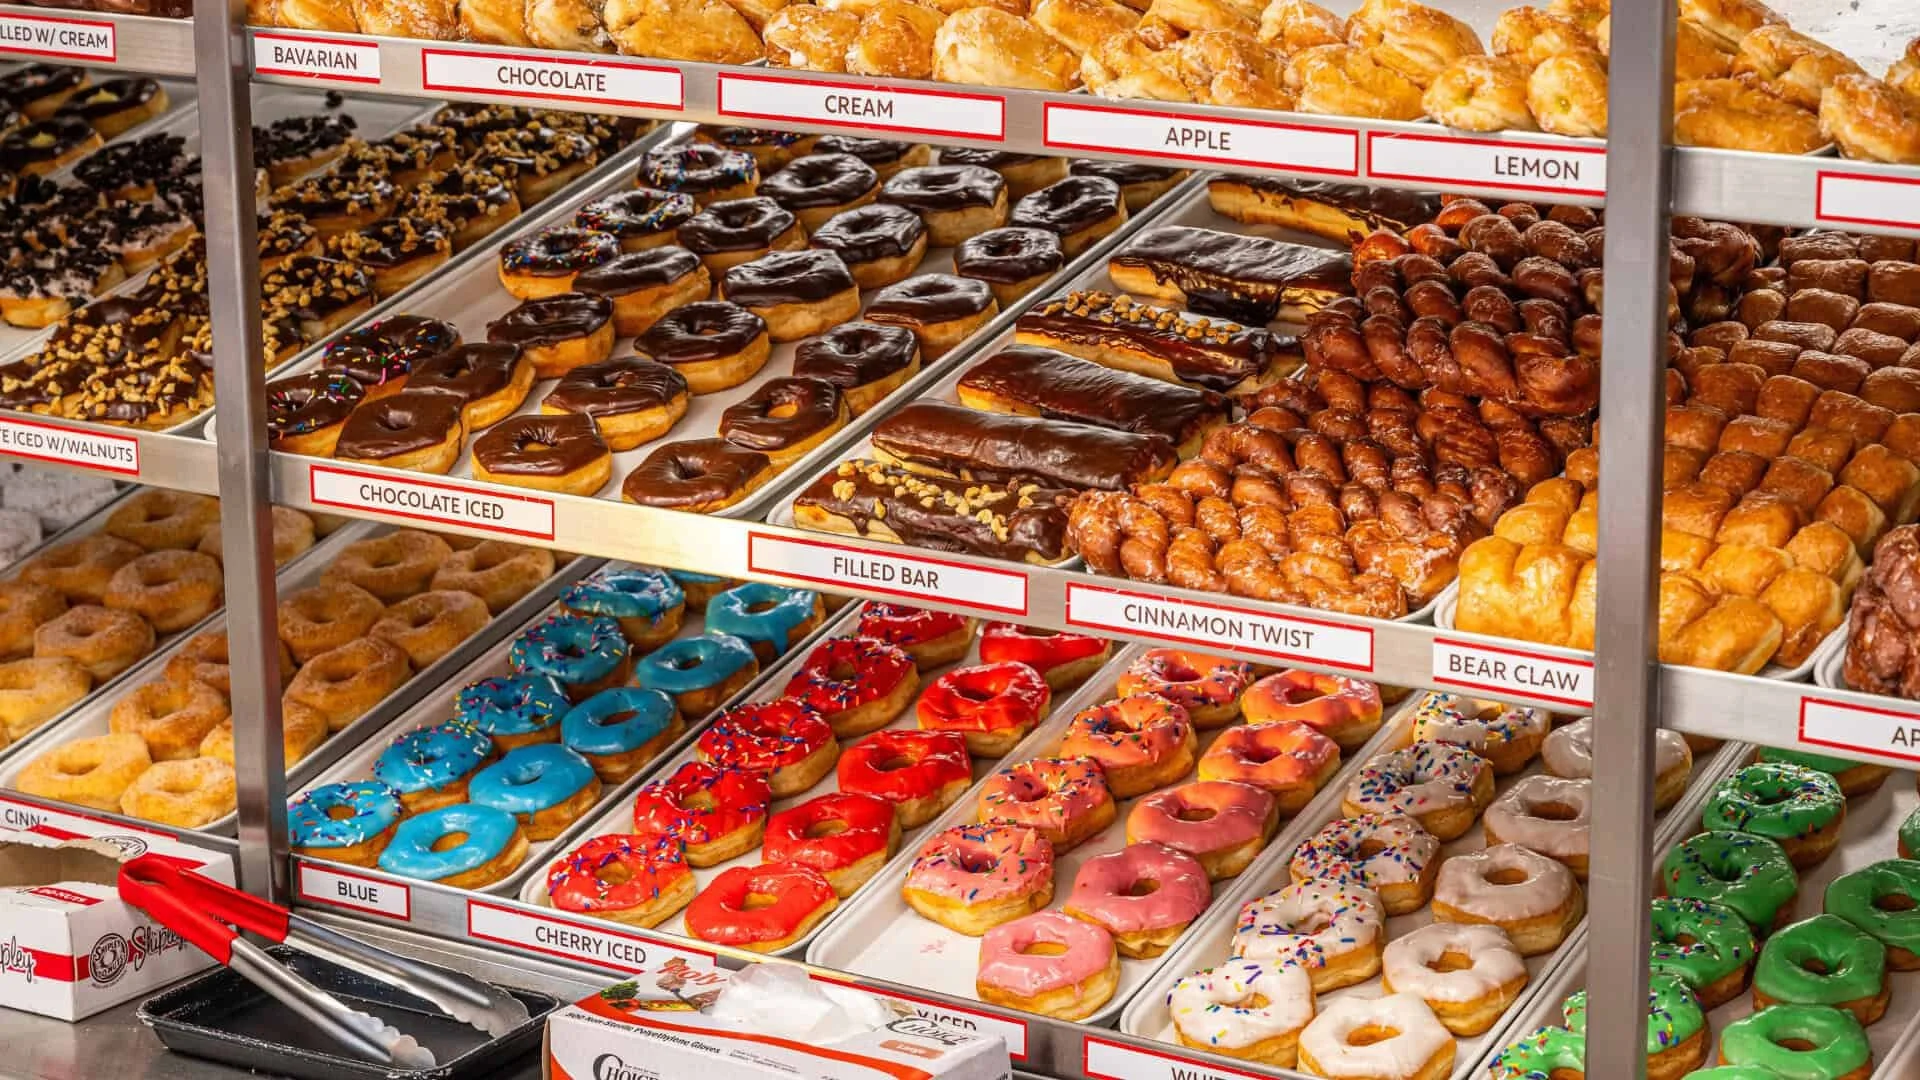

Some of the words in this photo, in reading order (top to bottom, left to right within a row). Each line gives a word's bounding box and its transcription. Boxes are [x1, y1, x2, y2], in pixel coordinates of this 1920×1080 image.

[35, 27, 56, 46] W/
[59, 31, 108, 49] CREAM
[273, 46, 357, 70] BAVARIAN
[497, 66, 606, 92] CHOCOLATE
[824, 94, 894, 119] CREAM
[1165, 127, 1231, 151] APPLE
[1494, 154, 1580, 181] LEMON
[0, 428, 9, 443] E
[13, 431, 44, 448] ICED
[47, 434, 133, 462] W/WALNUTS
[360, 484, 461, 515] CHOCOLATE
[465, 499, 504, 521] ICED
[833, 556, 895, 581] FILLED
[901, 566, 939, 590] BAR
[1124, 604, 1243, 639] CINNAMON
[1249, 622, 1314, 649] TWIST
[1449, 654, 1506, 681] BEAR
[1514, 665, 1579, 691] CLAW
[5, 809, 47, 826] CINN
[338, 881, 378, 903] BLUE
[536, 926, 604, 953] CHERRY
[607, 943, 647, 964] ICED
[633, 1027, 690, 1046] Polyethylene
[691, 1041, 721, 1054] Gloves
